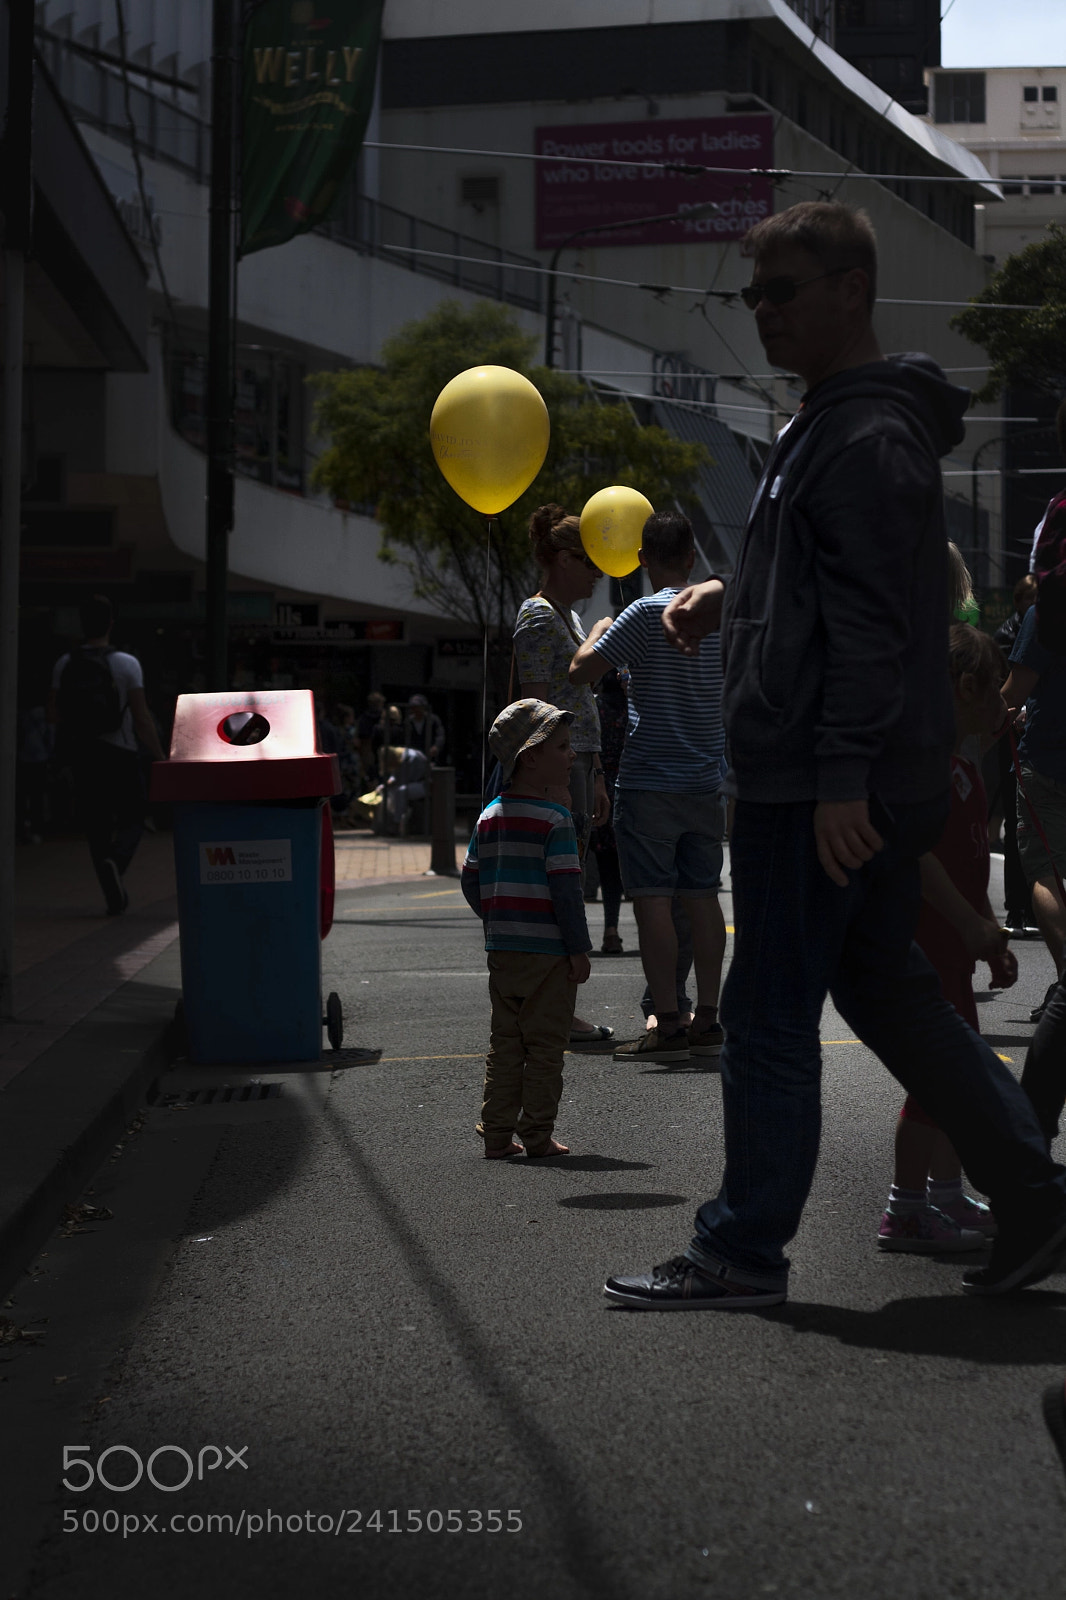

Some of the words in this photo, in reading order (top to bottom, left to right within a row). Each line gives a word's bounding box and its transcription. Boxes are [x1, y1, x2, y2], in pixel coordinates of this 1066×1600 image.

[253, 46, 363, 87] WELLY
[543, 140, 607, 157] Power
[612, 135, 662, 155] tools
[667, 132, 697, 153] for
[702, 130, 761, 151] ladies
[543, 165, 590, 184] who
[594, 164, 640, 182] love
[207, 871, 234, 880] 0800
[238, 869, 251, 880] 10
[256, 868, 269, 879] 10
[272, 868, 285, 878] 10
